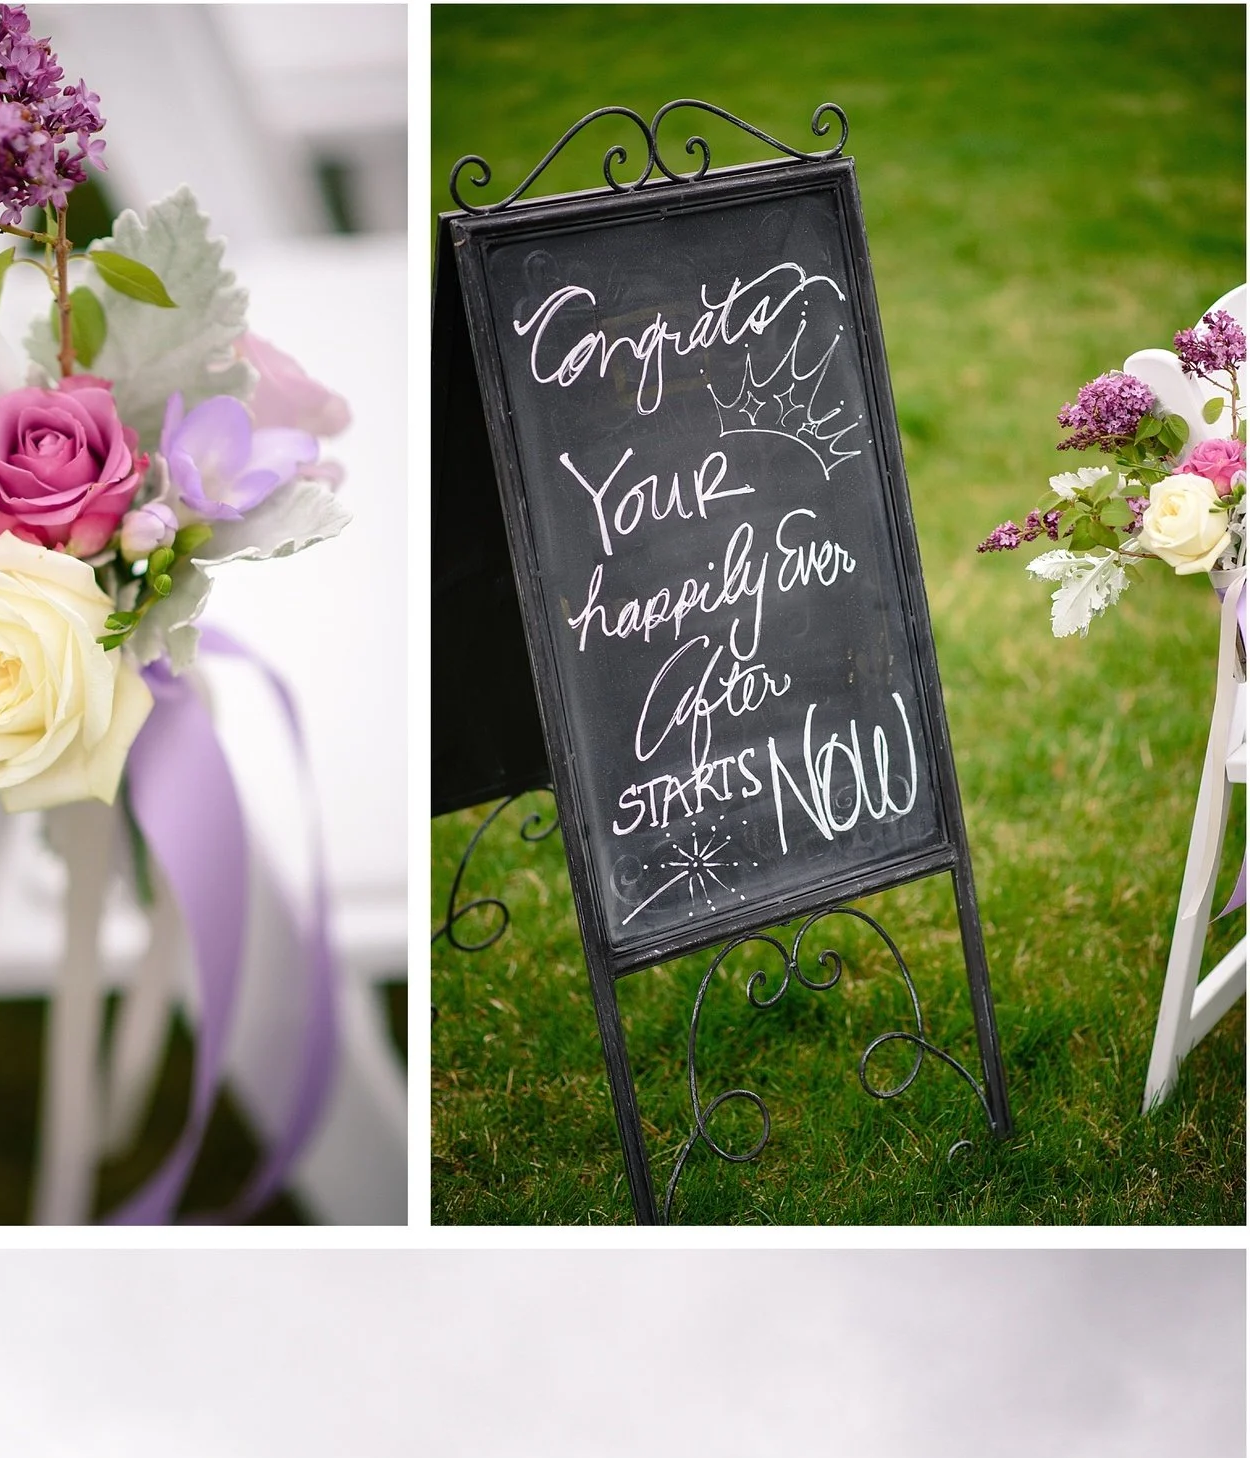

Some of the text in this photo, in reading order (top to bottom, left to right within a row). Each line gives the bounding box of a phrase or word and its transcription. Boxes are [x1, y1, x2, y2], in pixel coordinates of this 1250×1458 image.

[514, 262, 846, 415] Congrats
[568, 508, 856, 661] happily Ever
[612, 692, 918, 855] STARTS NOW
[634, 635, 791, 772] After
